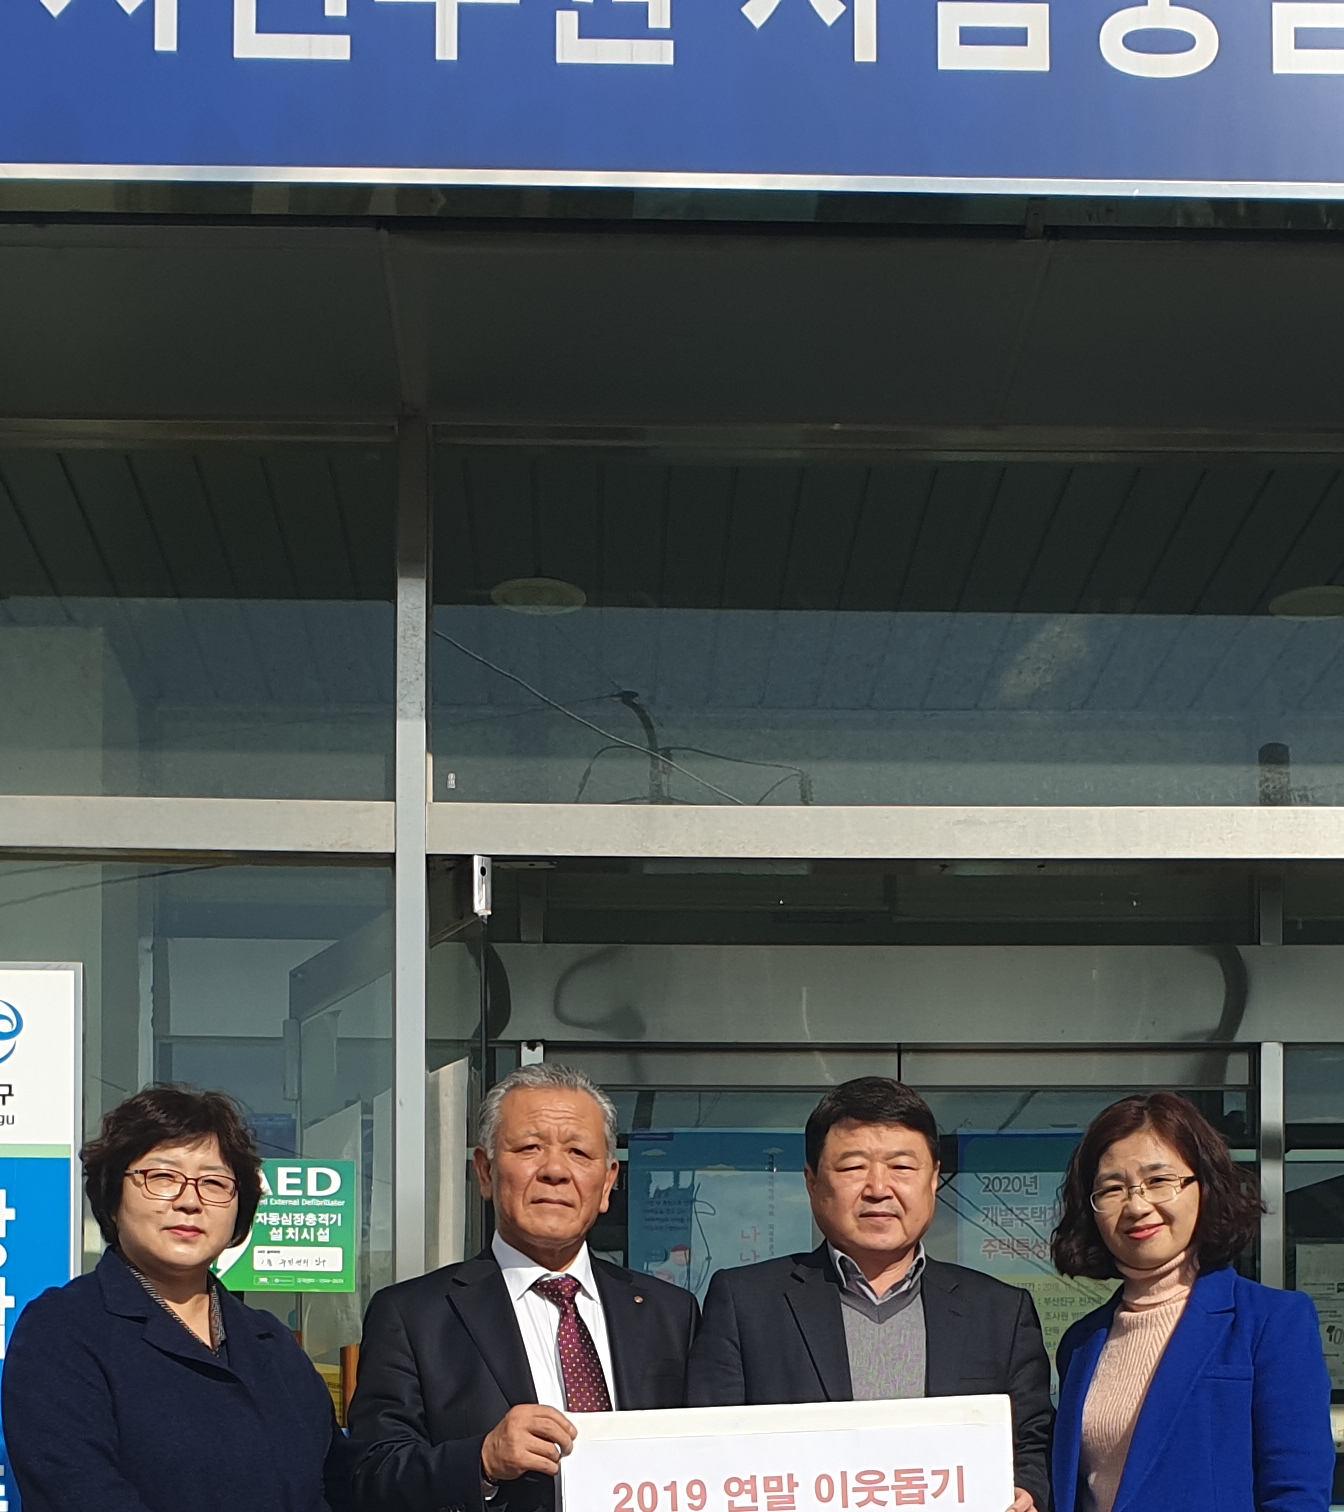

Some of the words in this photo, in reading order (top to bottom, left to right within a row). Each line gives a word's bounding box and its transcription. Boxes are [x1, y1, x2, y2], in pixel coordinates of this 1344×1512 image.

[982, 1175, 1038, 1196] 2020년
[256, 1212, 342, 1226] 자동심장충격기
[270, 1227, 330, 1242] 설치시설
[724, 1472, 799, 1512] 연말
[814, 1465, 966, 1510] 이웃돕기
